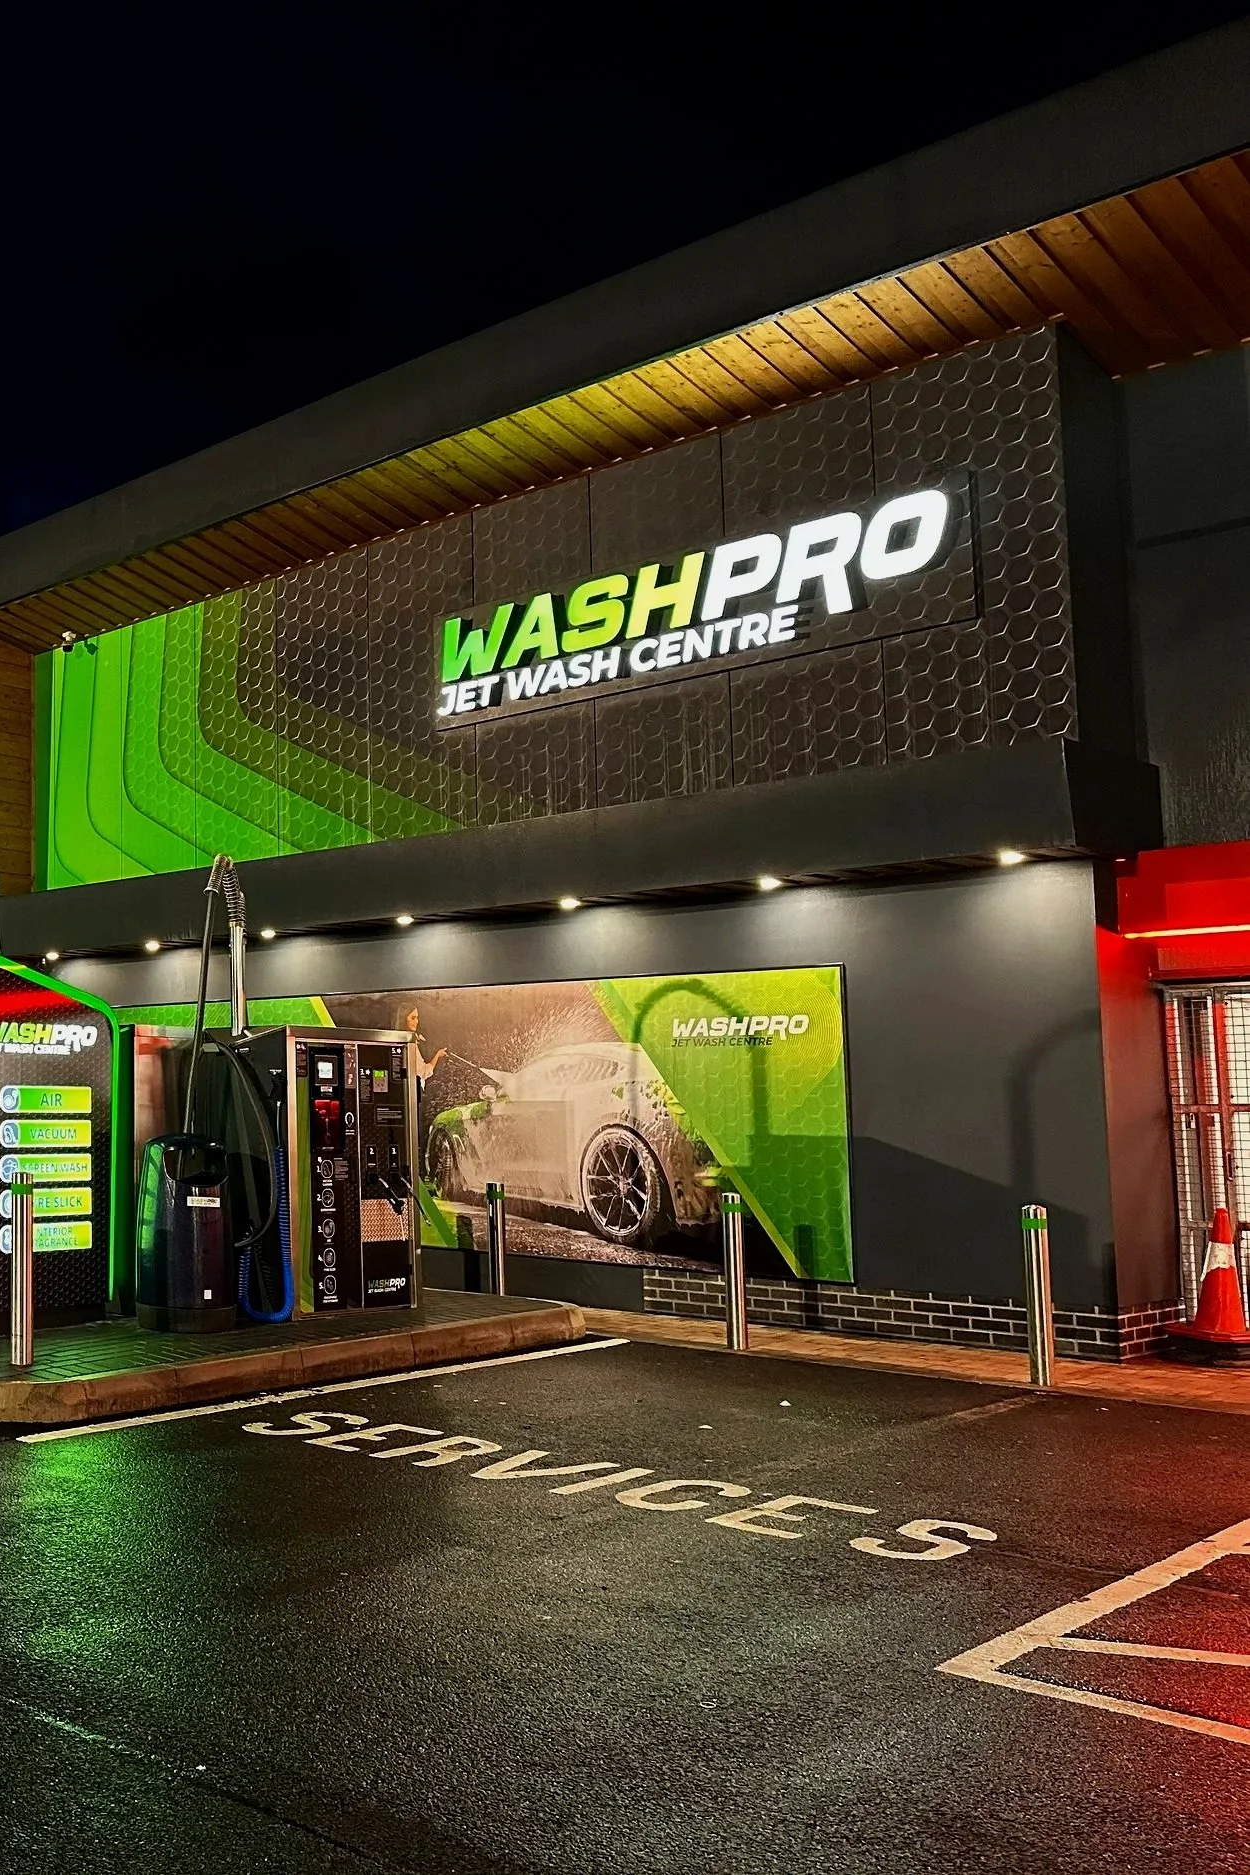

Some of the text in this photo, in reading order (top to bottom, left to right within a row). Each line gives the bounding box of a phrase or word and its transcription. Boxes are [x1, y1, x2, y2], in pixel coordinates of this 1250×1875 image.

[442, 489, 948, 682] WASHPRO
[437, 604, 799, 717] JET WASH CENTRE
[672, 1014, 810, 1040] WASHPRO
[672, 1036, 773, 1048] JET WASH CENTRE
[40, 1093, 62, 1106] AIR
[30, 1128, 77, 1139] VACUUM
[22, 1163, 88, 1172] SCREEN WASH
[38, 1196, 83, 1208] RE SLICK
[37, 1227, 73, 1237] NTERIOR
[35, 1237, 78, 1248] AGRANCE
[367, 1277, 406, 1289] WASHPRO
[242, 1410, 998, 1562] SERVICES
